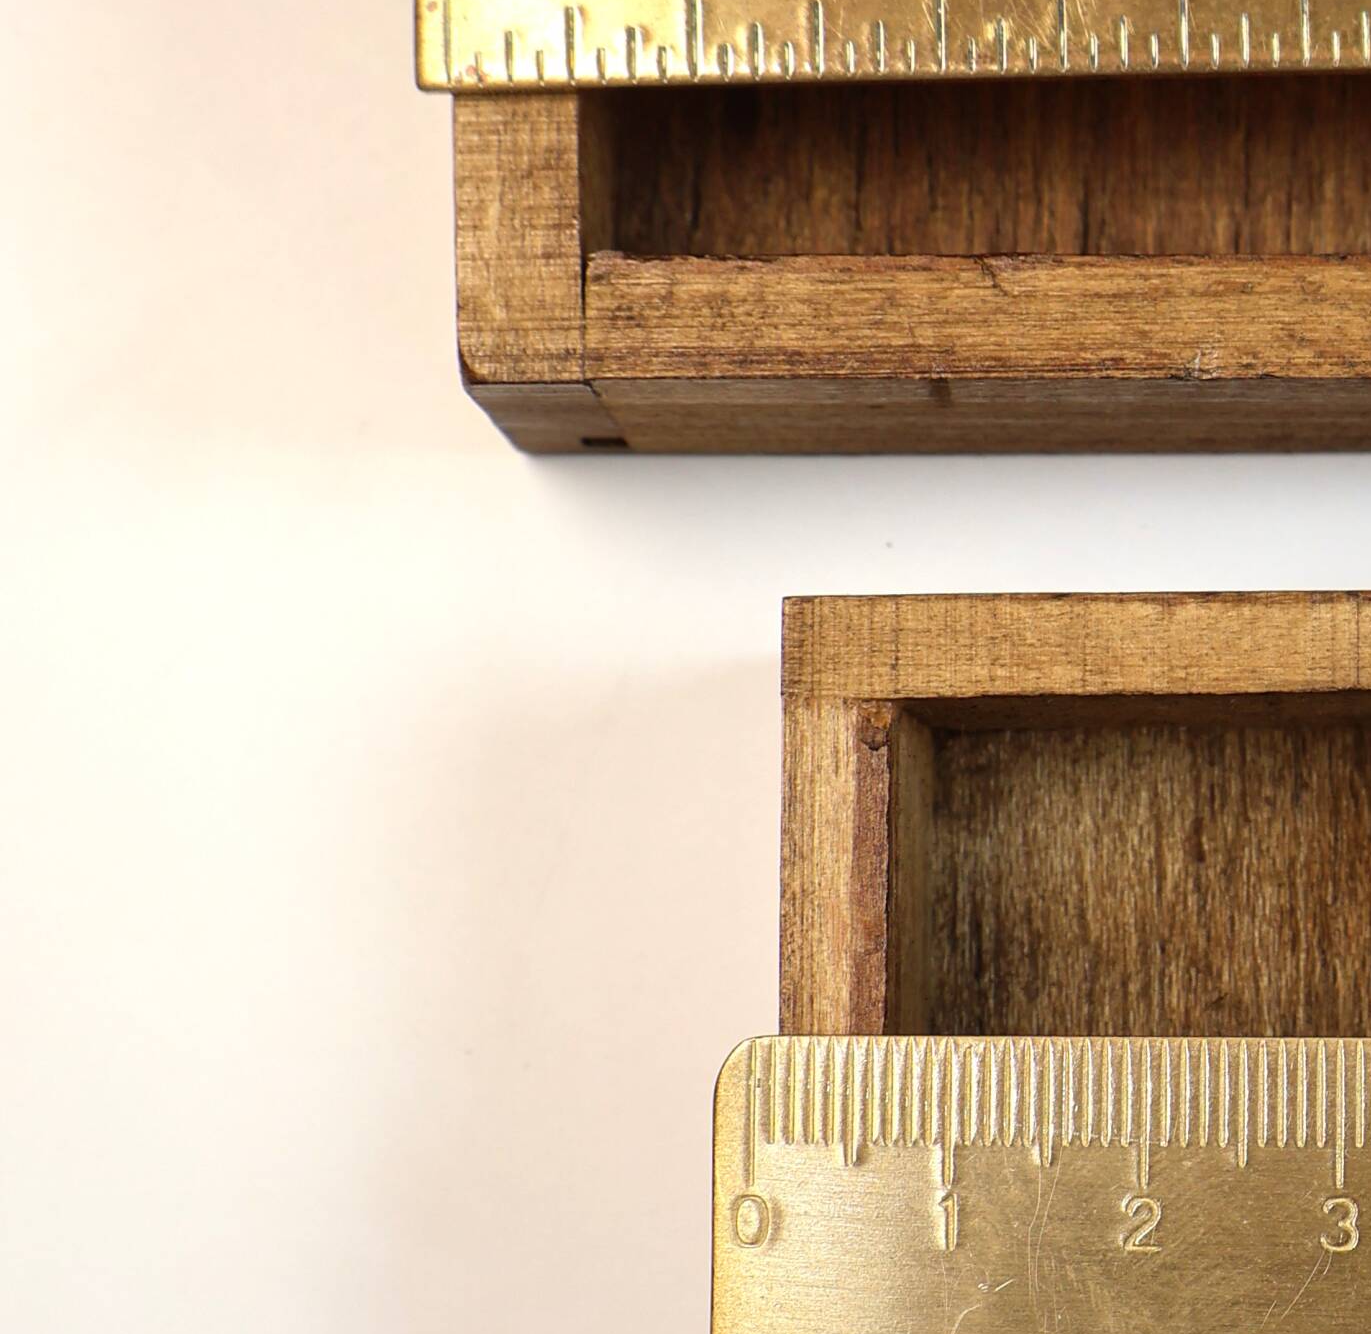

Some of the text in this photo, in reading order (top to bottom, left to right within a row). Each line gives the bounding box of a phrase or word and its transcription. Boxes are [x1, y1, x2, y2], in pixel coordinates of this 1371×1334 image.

[730, 1193, 772, 1249] 0
[936, 1193, 959, 1251] 1
[1121, 1197, 1162, 1252] 2
[1319, 1197, 1360, 1253] 3
